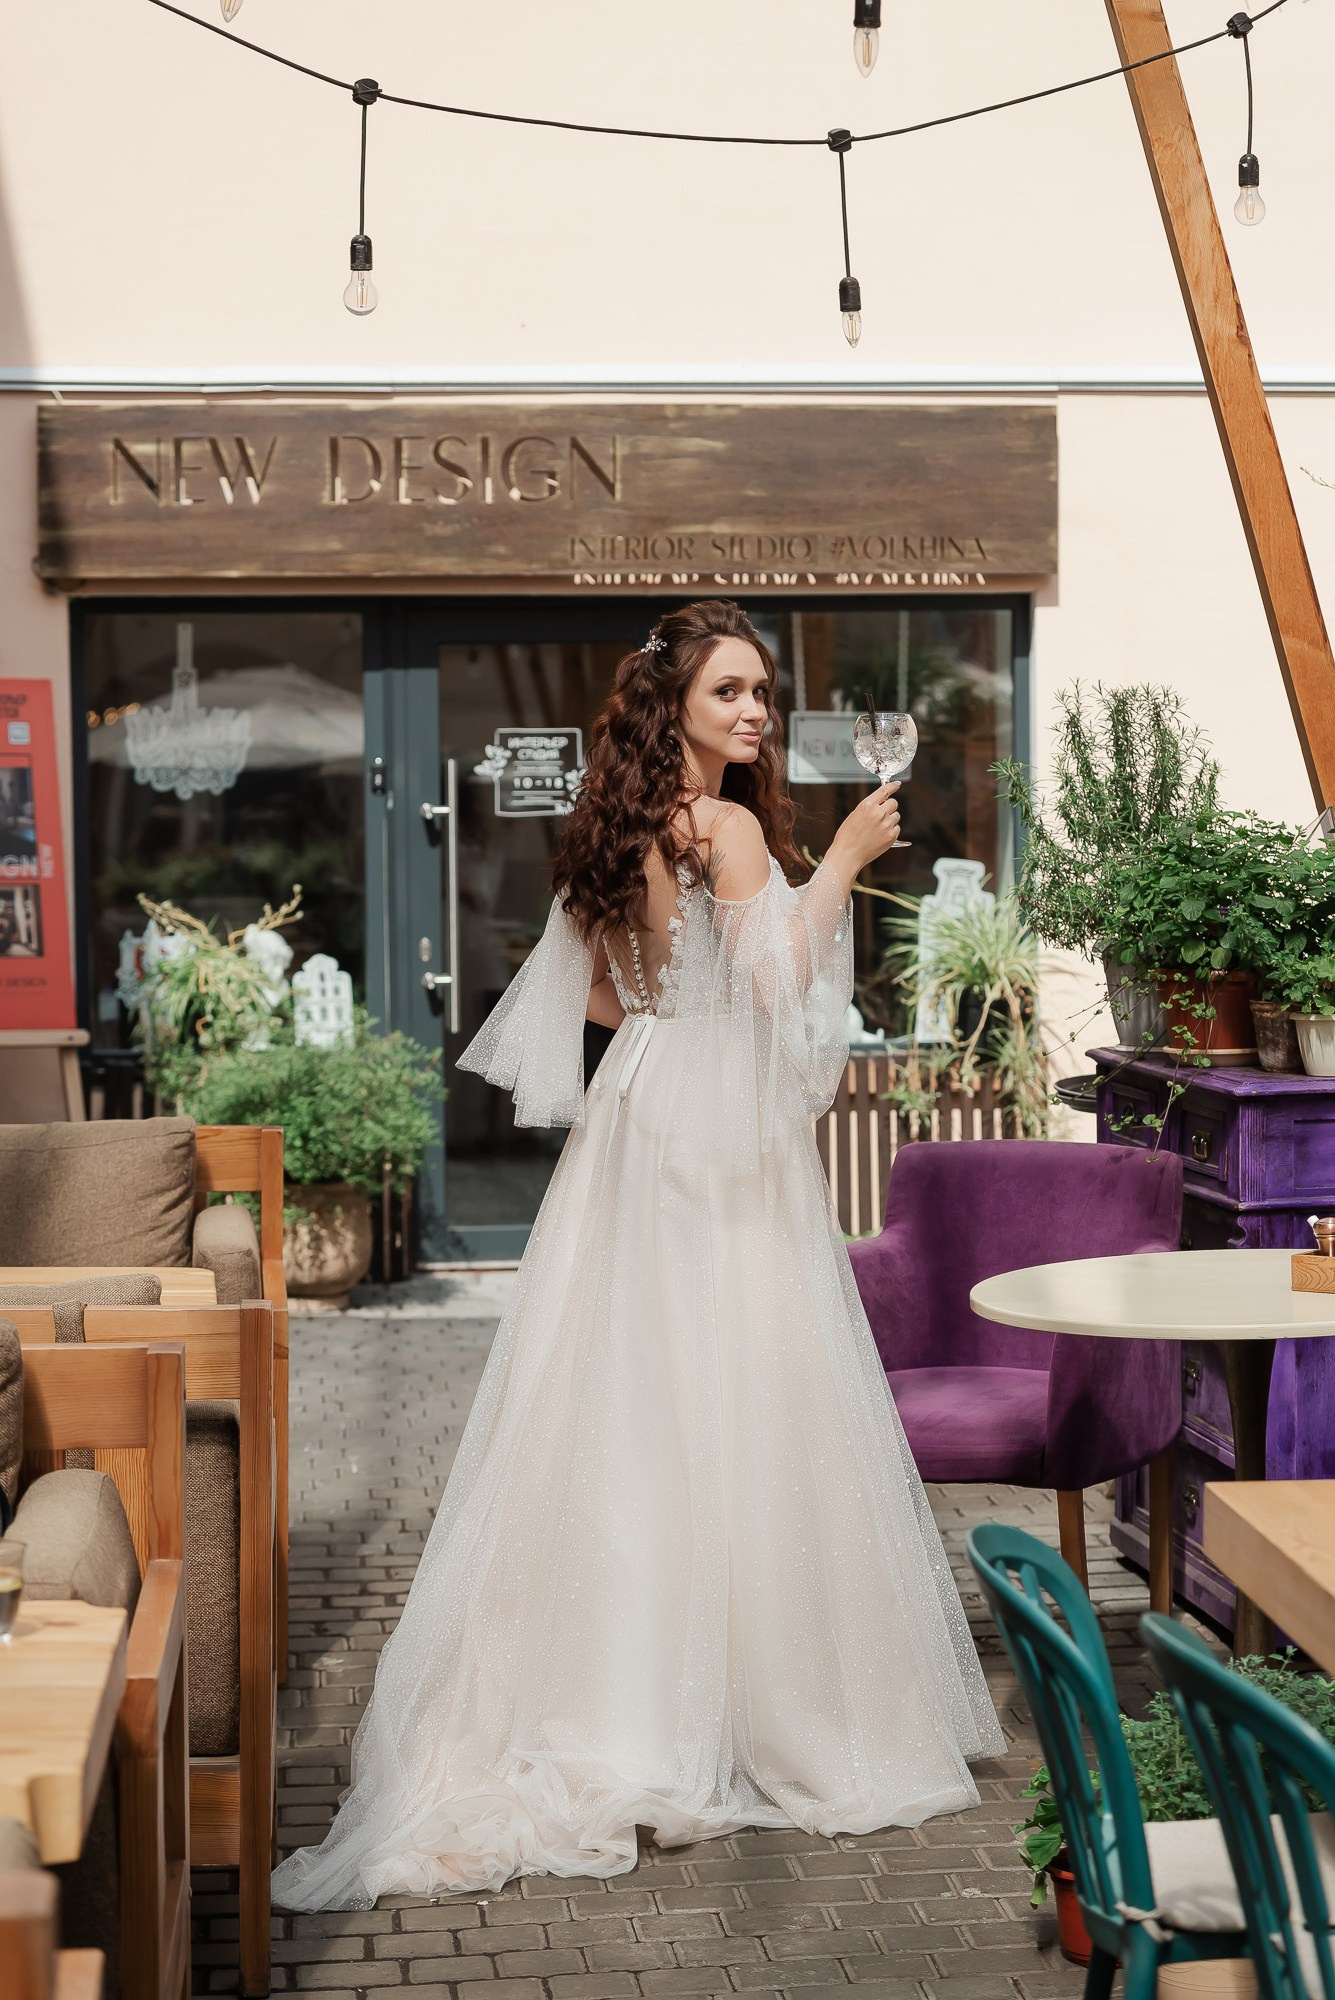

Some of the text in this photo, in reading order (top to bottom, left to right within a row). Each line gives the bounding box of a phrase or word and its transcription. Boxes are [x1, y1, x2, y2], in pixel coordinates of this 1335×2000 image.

[110, 435, 623, 506] NEW DESIGN
[569, 535, 988, 562] INTERIOR STUDIO #VOLKHINA
